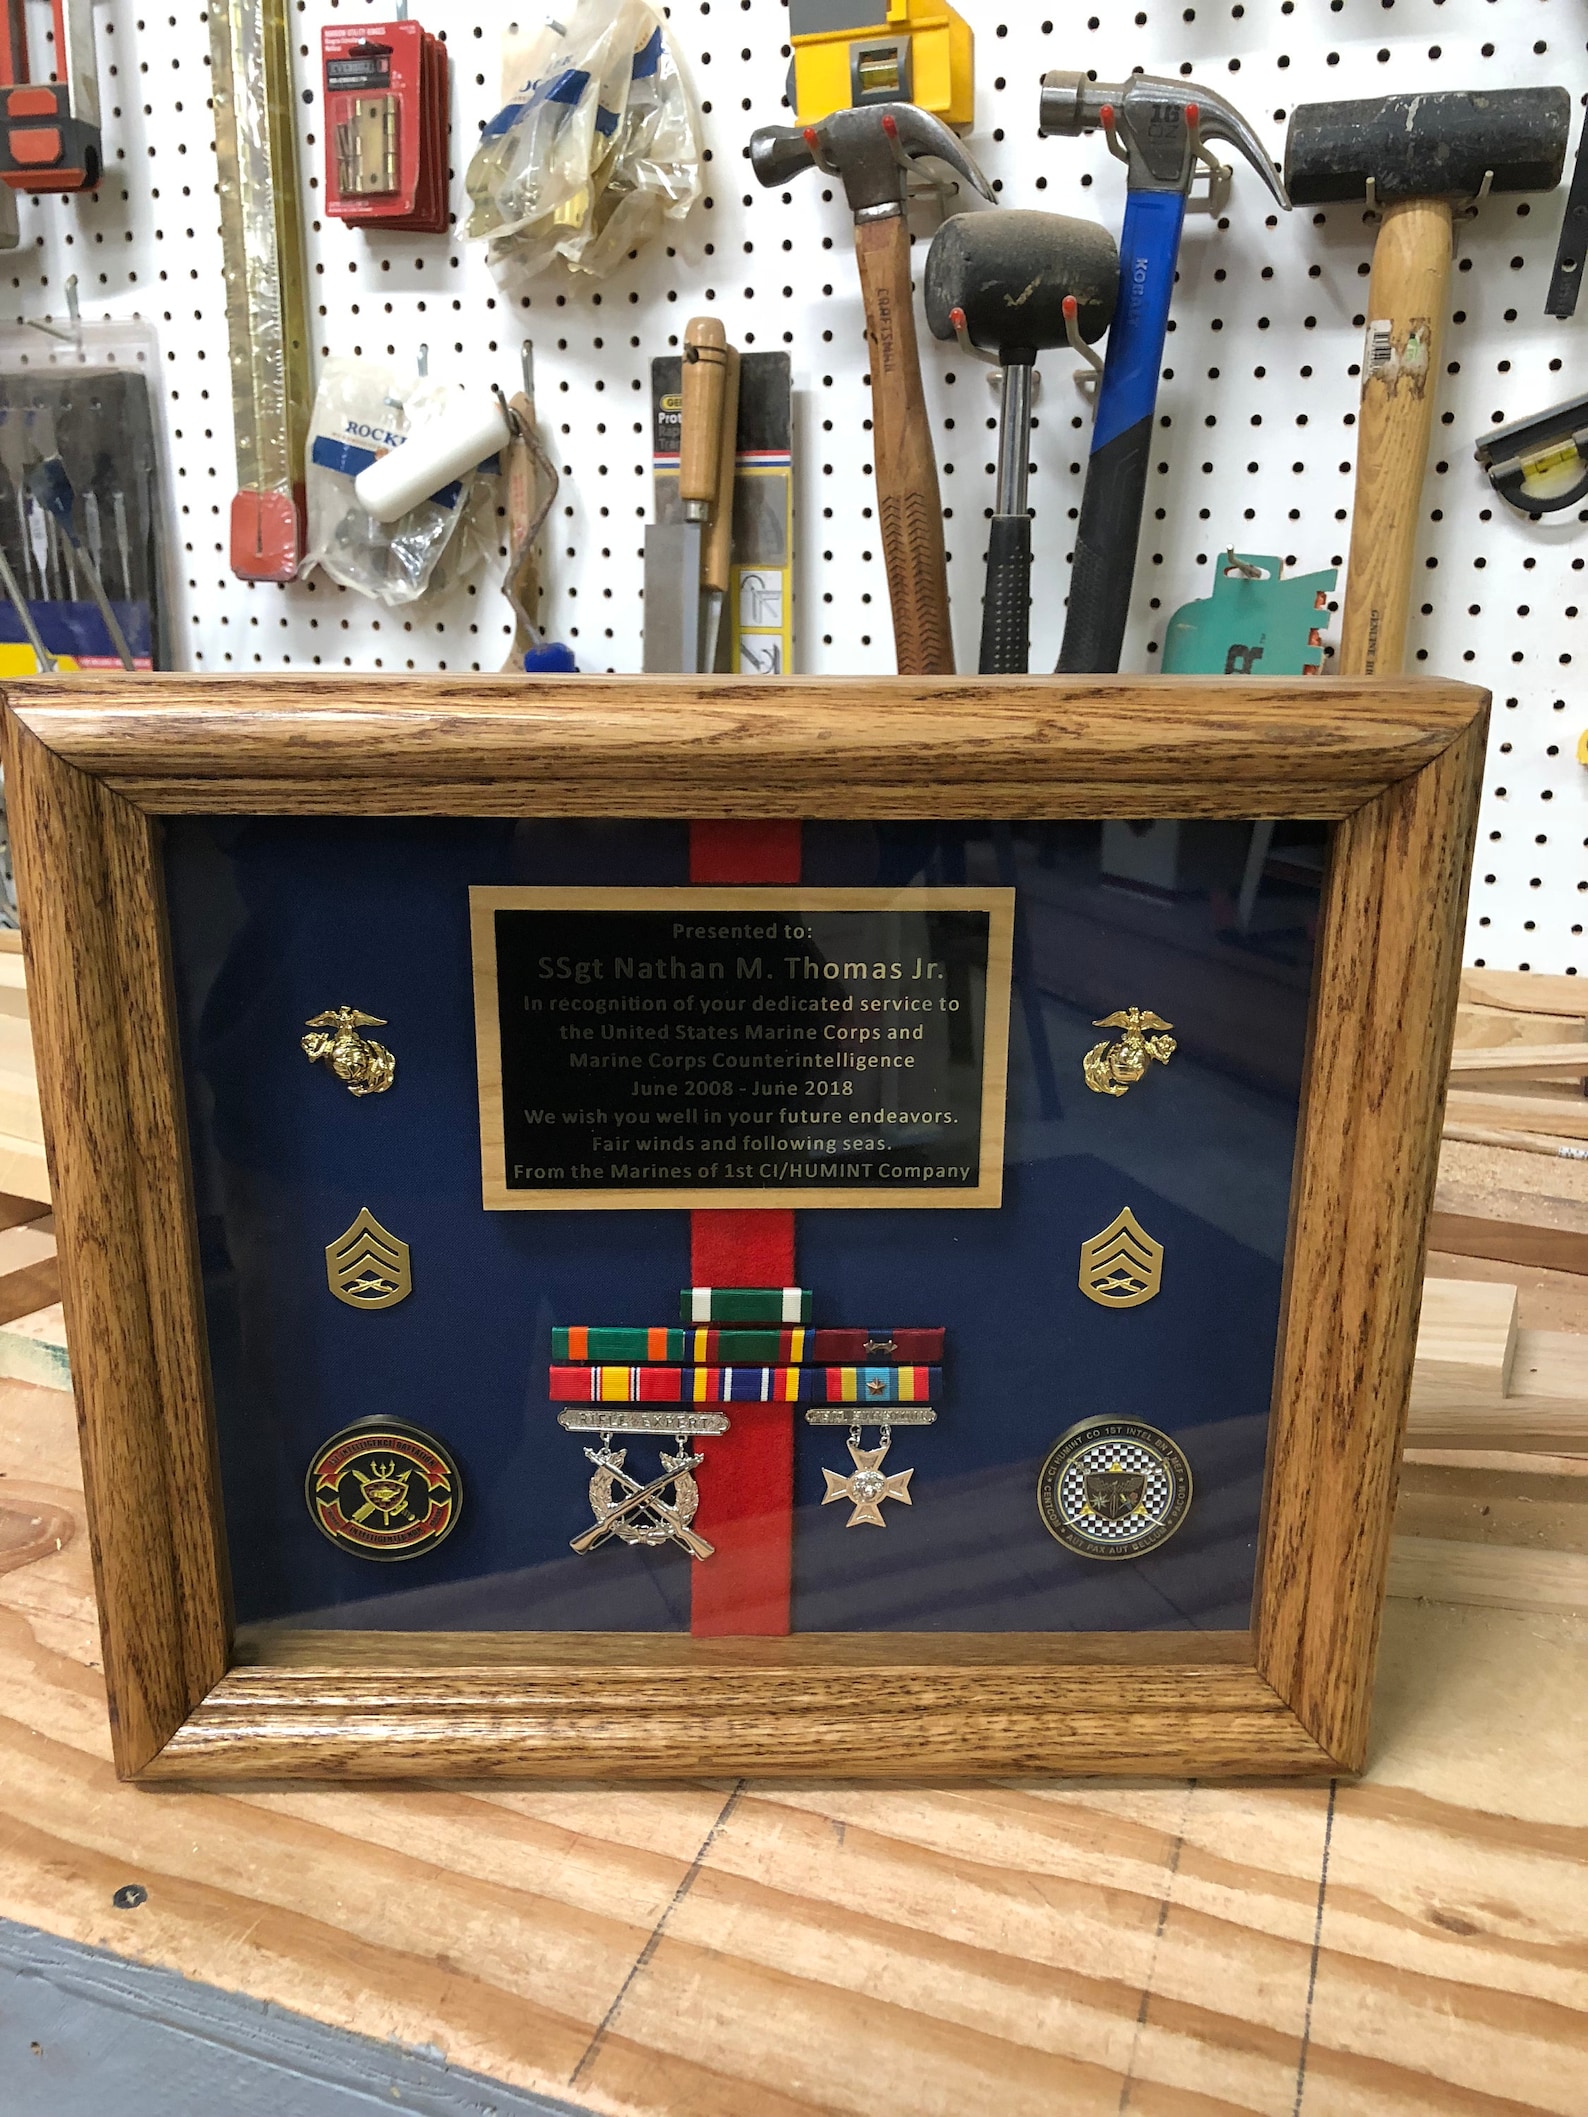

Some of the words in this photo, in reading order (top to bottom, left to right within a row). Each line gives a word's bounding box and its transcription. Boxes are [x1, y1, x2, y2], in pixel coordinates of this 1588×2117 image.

[1151, 104, 1180, 123] 16
[1148, 124, 1179, 138] OZ
[1368, 609, 1379, 657] GENUINE
[672, 922, 778, 939] Presented
[783, 924, 813, 940] to:
[537, 956, 604, 985] SSgt
[614, 955, 725, 980] Nathan
[736, 956, 773, 980] M.
[783, 956, 903, 980] Thomas
[911, 957, 944, 980] Jr.
[523, 995, 543, 1011] In
[549, 995, 667, 1015] recognition
[672, 994, 695, 1012] of
[699, 999, 747, 1015] your
[751, 995, 854, 1012] dedicated
[859, 996, 933, 1012] service
[938, 997, 960, 1012] to
[559, 1024, 594, 1040] the
[600, 1023, 669, 1040] United
[674, 1024, 739, 1040] States
[745, 1024, 818, 1040] Marine
[823, 1024, 881, 1043] Corps
[886, 1024, 924, 1040] and
[569, 1052, 643, 1069] Marine
[648, 1052, 707, 1072] Corps
[712, 1052, 915, 1071] Counterintelligence
[630, 1081, 678, 1097] June
[684, 1080, 734, 1096] 2008
[751, 1081, 798, 1096] June
[804, 1080, 854, 1096] 2018
[523, 1109, 556, 1125] We
[561, 1108, 608, 1125] wish
[613, 1112, 650, 1127] you
[655, 1108, 698, 1124] well
[703, 1108, 722, 1124] in
[727, 1111, 774, 1127] your
[778, 1107, 842, 1124] future
[848, 1108, 959, 1124] endeavors.
[592, 1136, 631, 1152] Fair
[635, 1135, 695, 1152] winds
[700, 1135, 737, 1151] and
[742, 1135, 838, 1154] following
[842, 1138, 893, 1151] seas.
[513, 1164, 565, 1179] From
[570, 1163, 604, 1179] the
[610, 1163, 692, 1179] Marines
[697, 1162, 719, 1179] of
[724, 1163, 754, 1178] 1st
[759, 1161, 874, 1180] CI/HUMINT
[878, 1163, 971, 1181] Company
[579, 1412, 627, 1426] RIFLE
[641, 1414, 708, 1429] EXPERT
[340, 1439, 393, 1458] INTELLIGENCE
[1054, 1436, 1084, 1465] HUMINT
[1086, 1429, 1101, 1440] CO
[1105, 1426, 1123, 1435] 1ST
[1126, 1427, 1153, 1441] INTEL
[1043, 1484, 1063, 1528] CENTCOM
[1066, 1533, 1084, 1548] AUT
[1087, 1543, 1106, 1555] PAX
[1108, 1545, 1130, 1555] AUT
[1132, 1526, 1169, 1552] BELLUM
